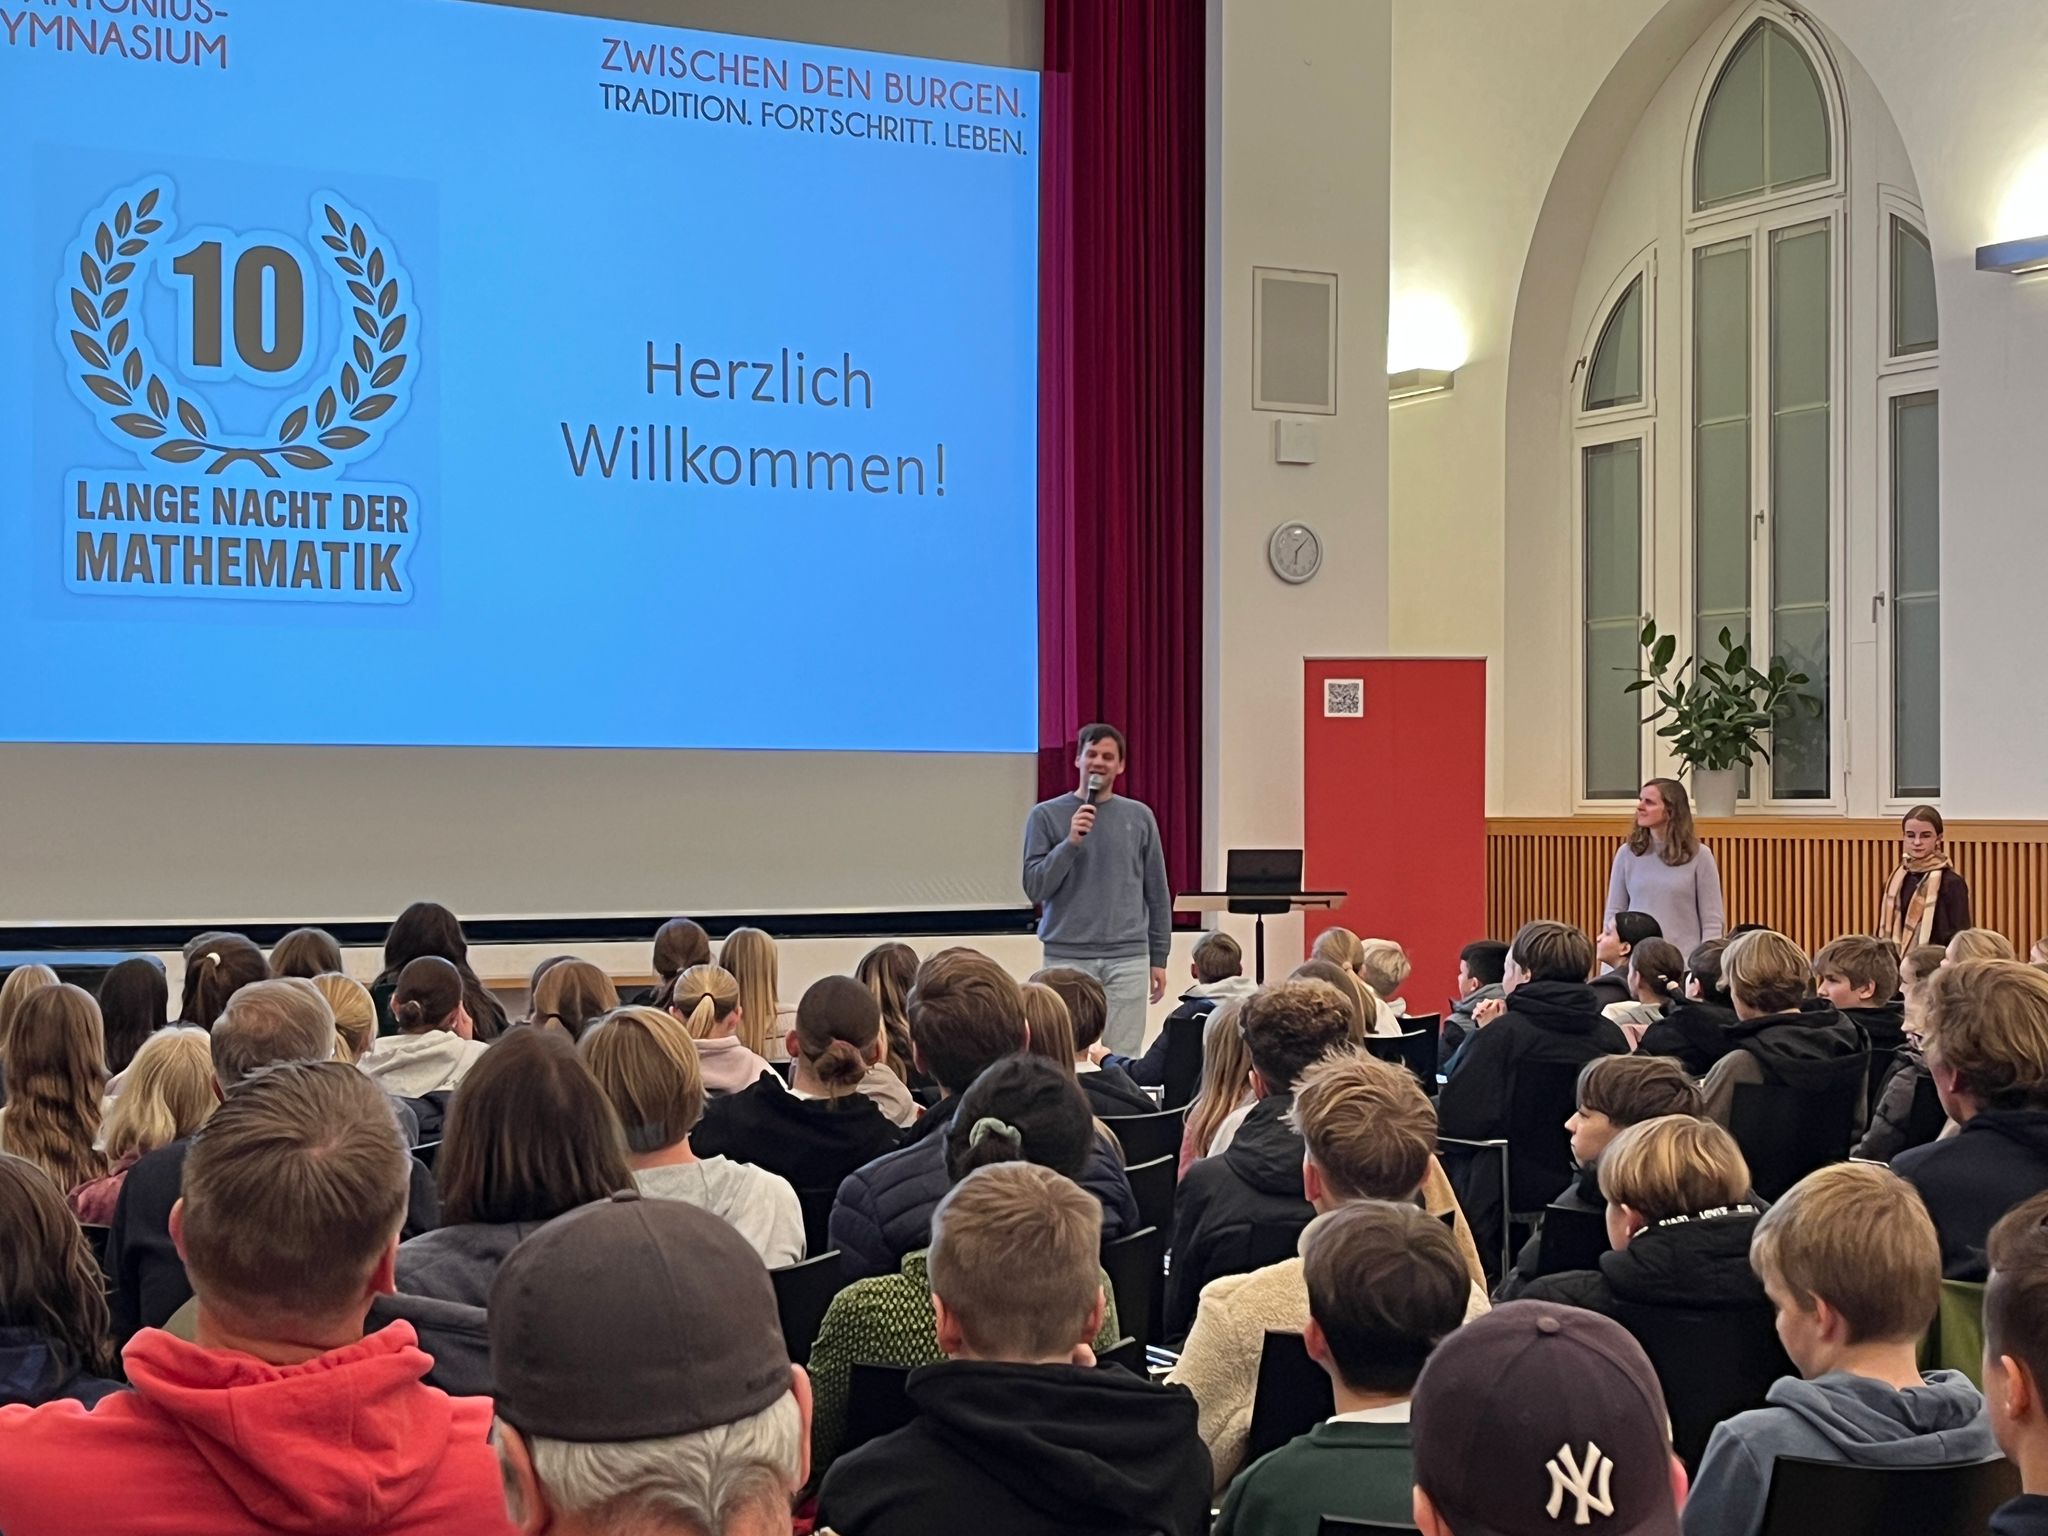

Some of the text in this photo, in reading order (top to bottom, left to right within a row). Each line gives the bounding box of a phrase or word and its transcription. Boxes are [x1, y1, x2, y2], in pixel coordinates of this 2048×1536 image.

[0, 8, 227, 69] YMNASIUM
[24, 0, 228, 24] NIUS-
[601, 39, 1026, 118] ZWISCHEN DEN BURGEN.
[599, 83, 1026, 155] TRADITION. FORTSCHRITT. LEBEN.
[173, 241, 304, 372] 10
[647, 341, 870, 408] Herzlich
[561, 423, 944, 496] Willkommen!
[78, 481, 408, 533] LANGE NACHT DER
[77, 531, 401, 592] MATHEMATIK
[1545, 1441, 1615, 1525] NY
